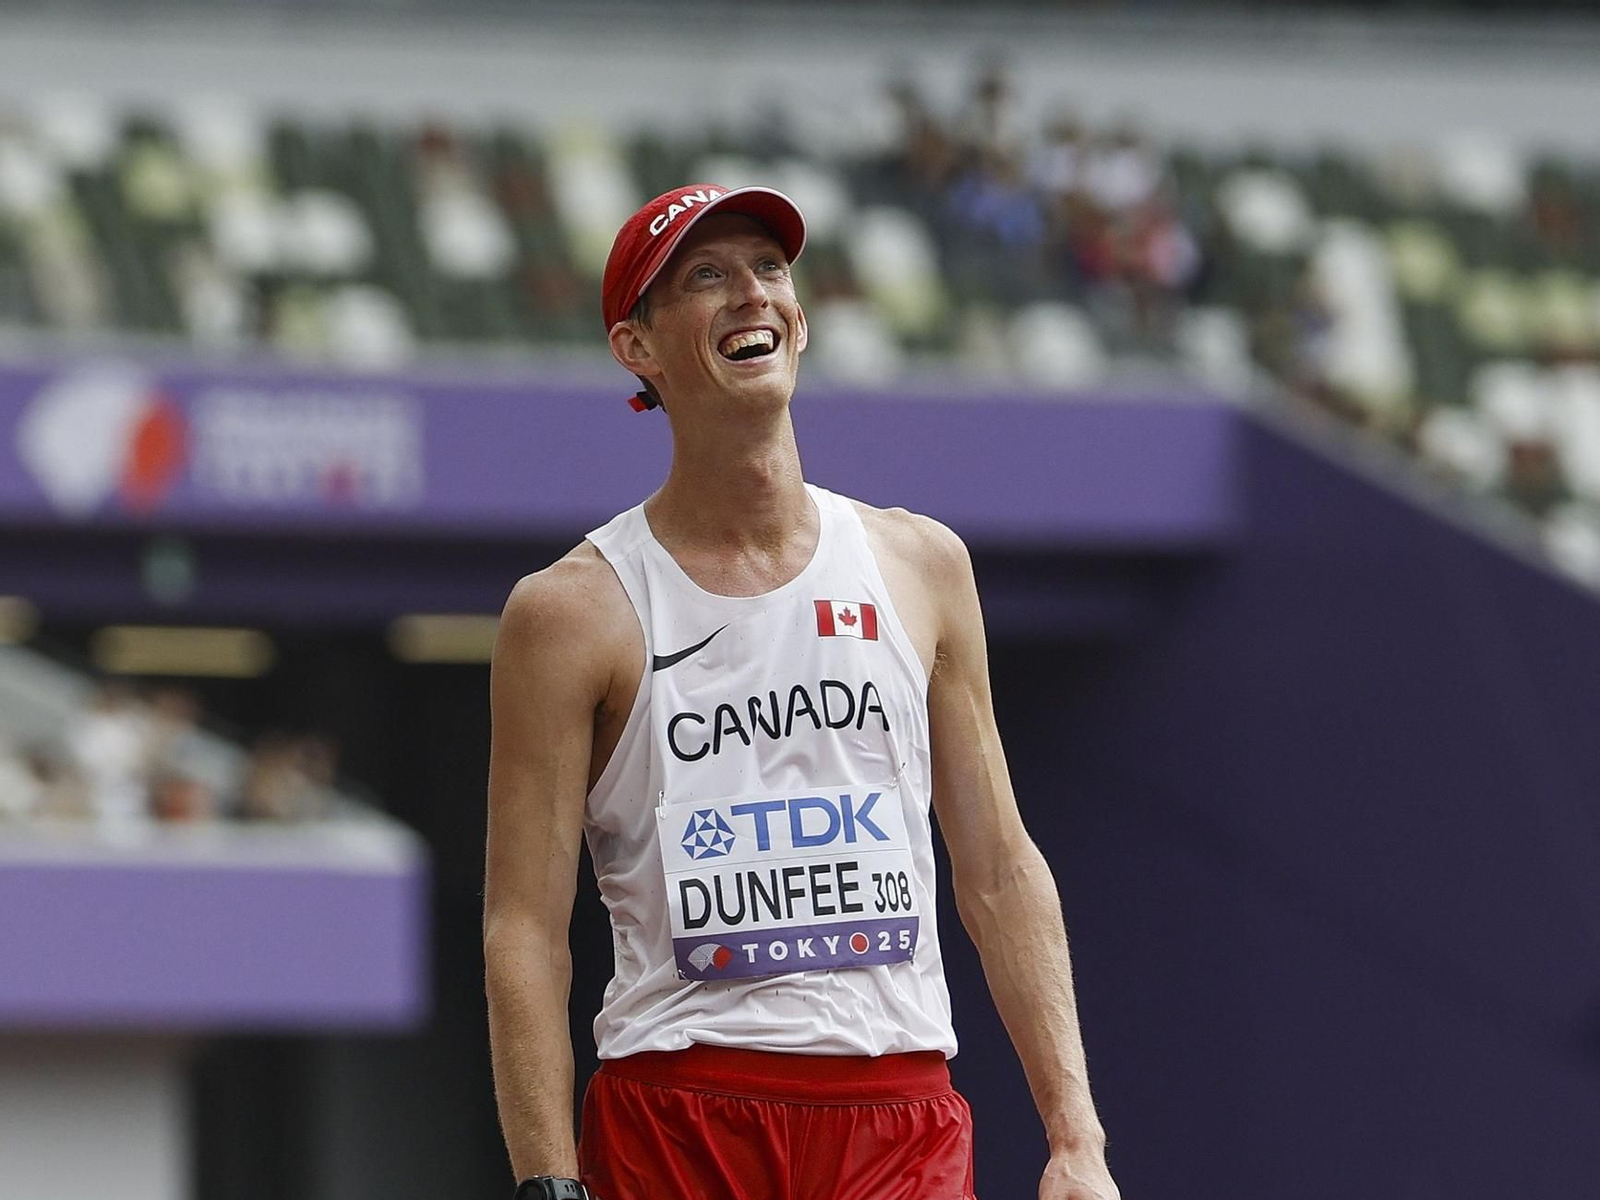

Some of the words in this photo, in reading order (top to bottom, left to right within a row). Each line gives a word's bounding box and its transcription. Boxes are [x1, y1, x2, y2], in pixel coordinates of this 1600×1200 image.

[649, 189, 727, 236] CANA
[667, 680, 890, 761] CANADA
[731, 792, 891, 851] TDK
[679, 862, 864, 930] DUNFEE
[872, 871, 912, 914] 308
